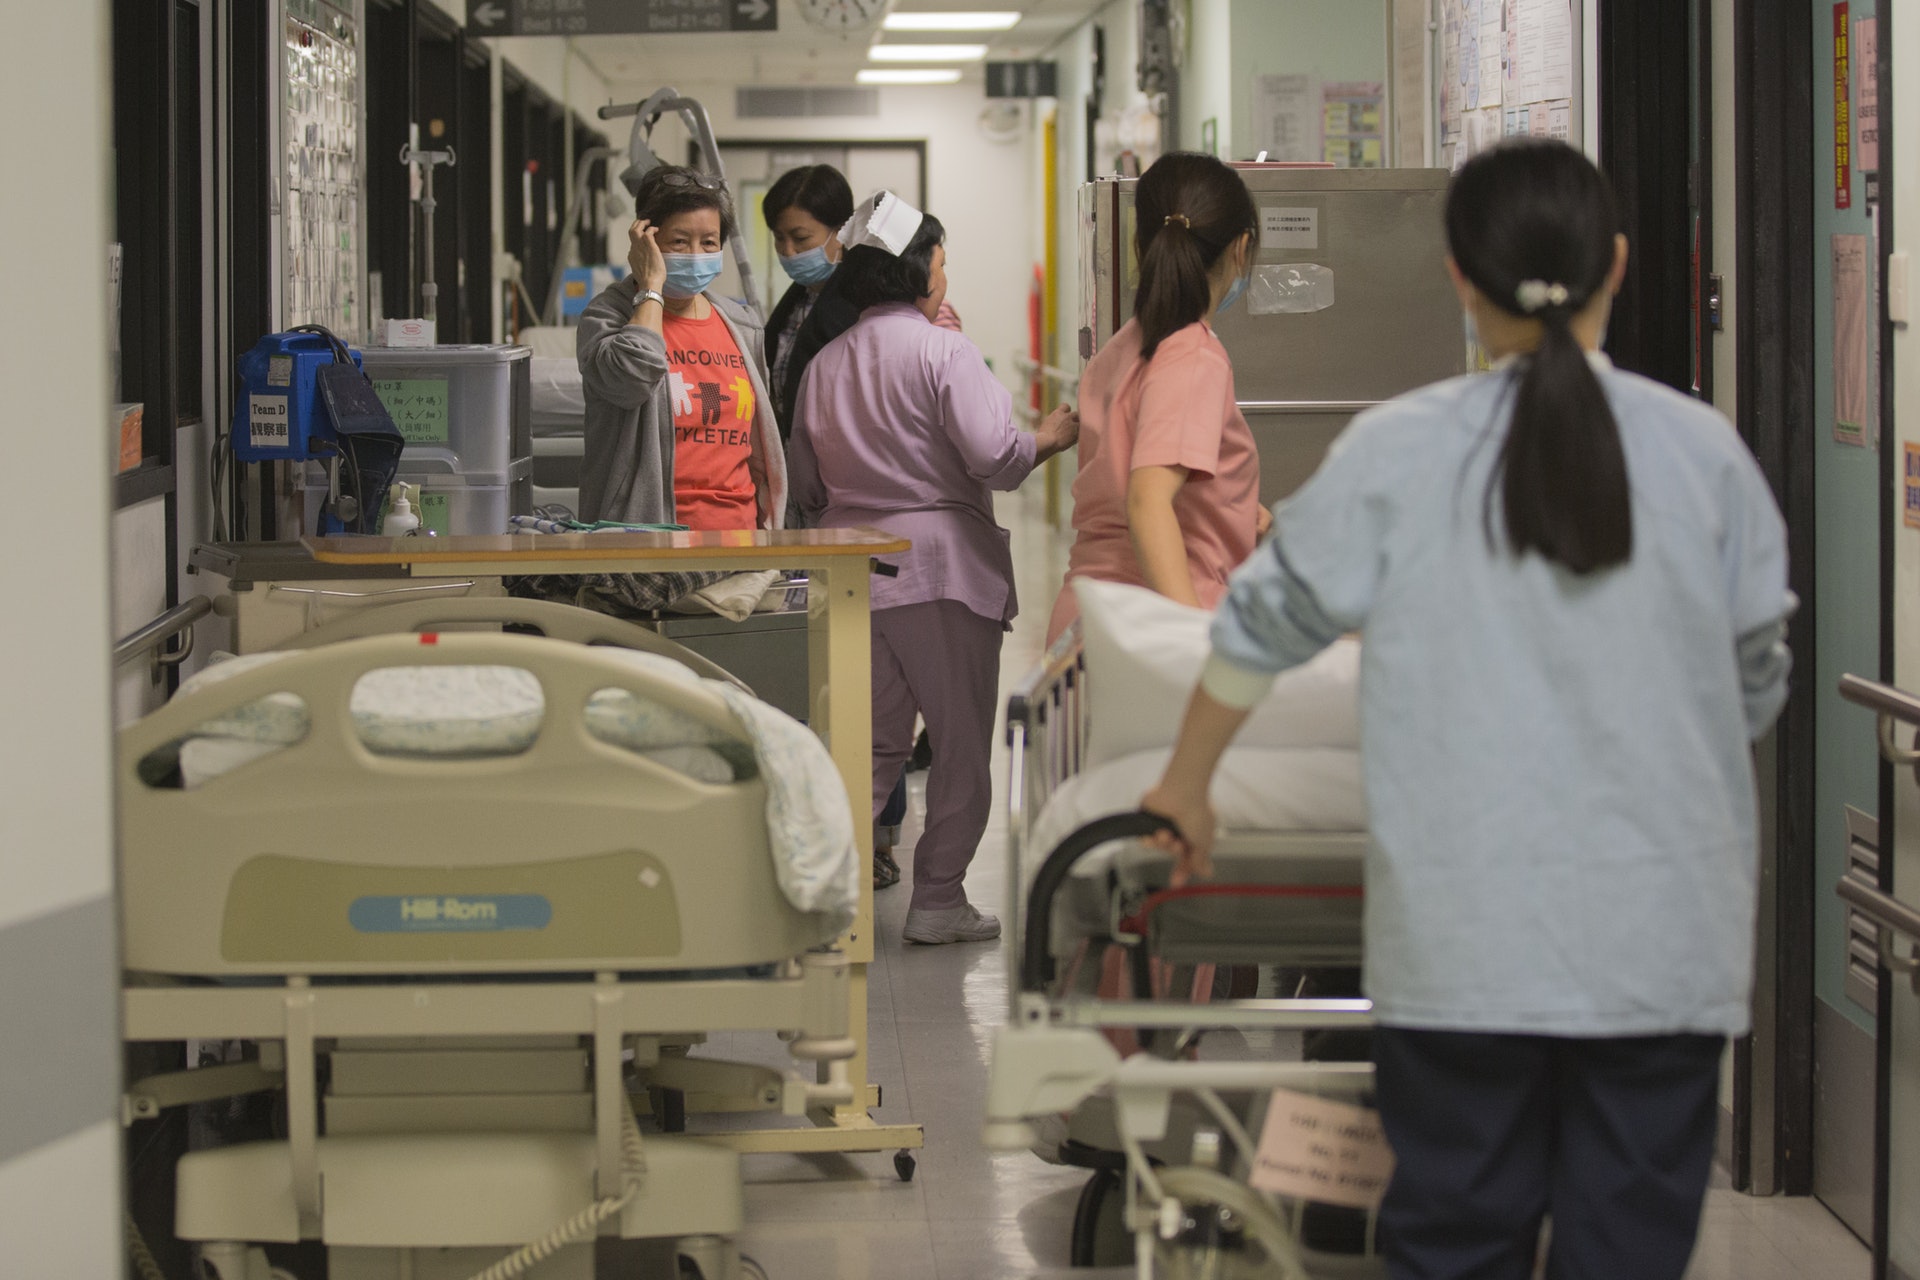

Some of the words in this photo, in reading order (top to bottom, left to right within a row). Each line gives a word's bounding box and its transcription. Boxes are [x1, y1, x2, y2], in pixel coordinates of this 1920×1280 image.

[252, 403, 276, 415] Team
[278, 404, 286, 415] D
[401, 897, 497, 921] Hill-Rom
